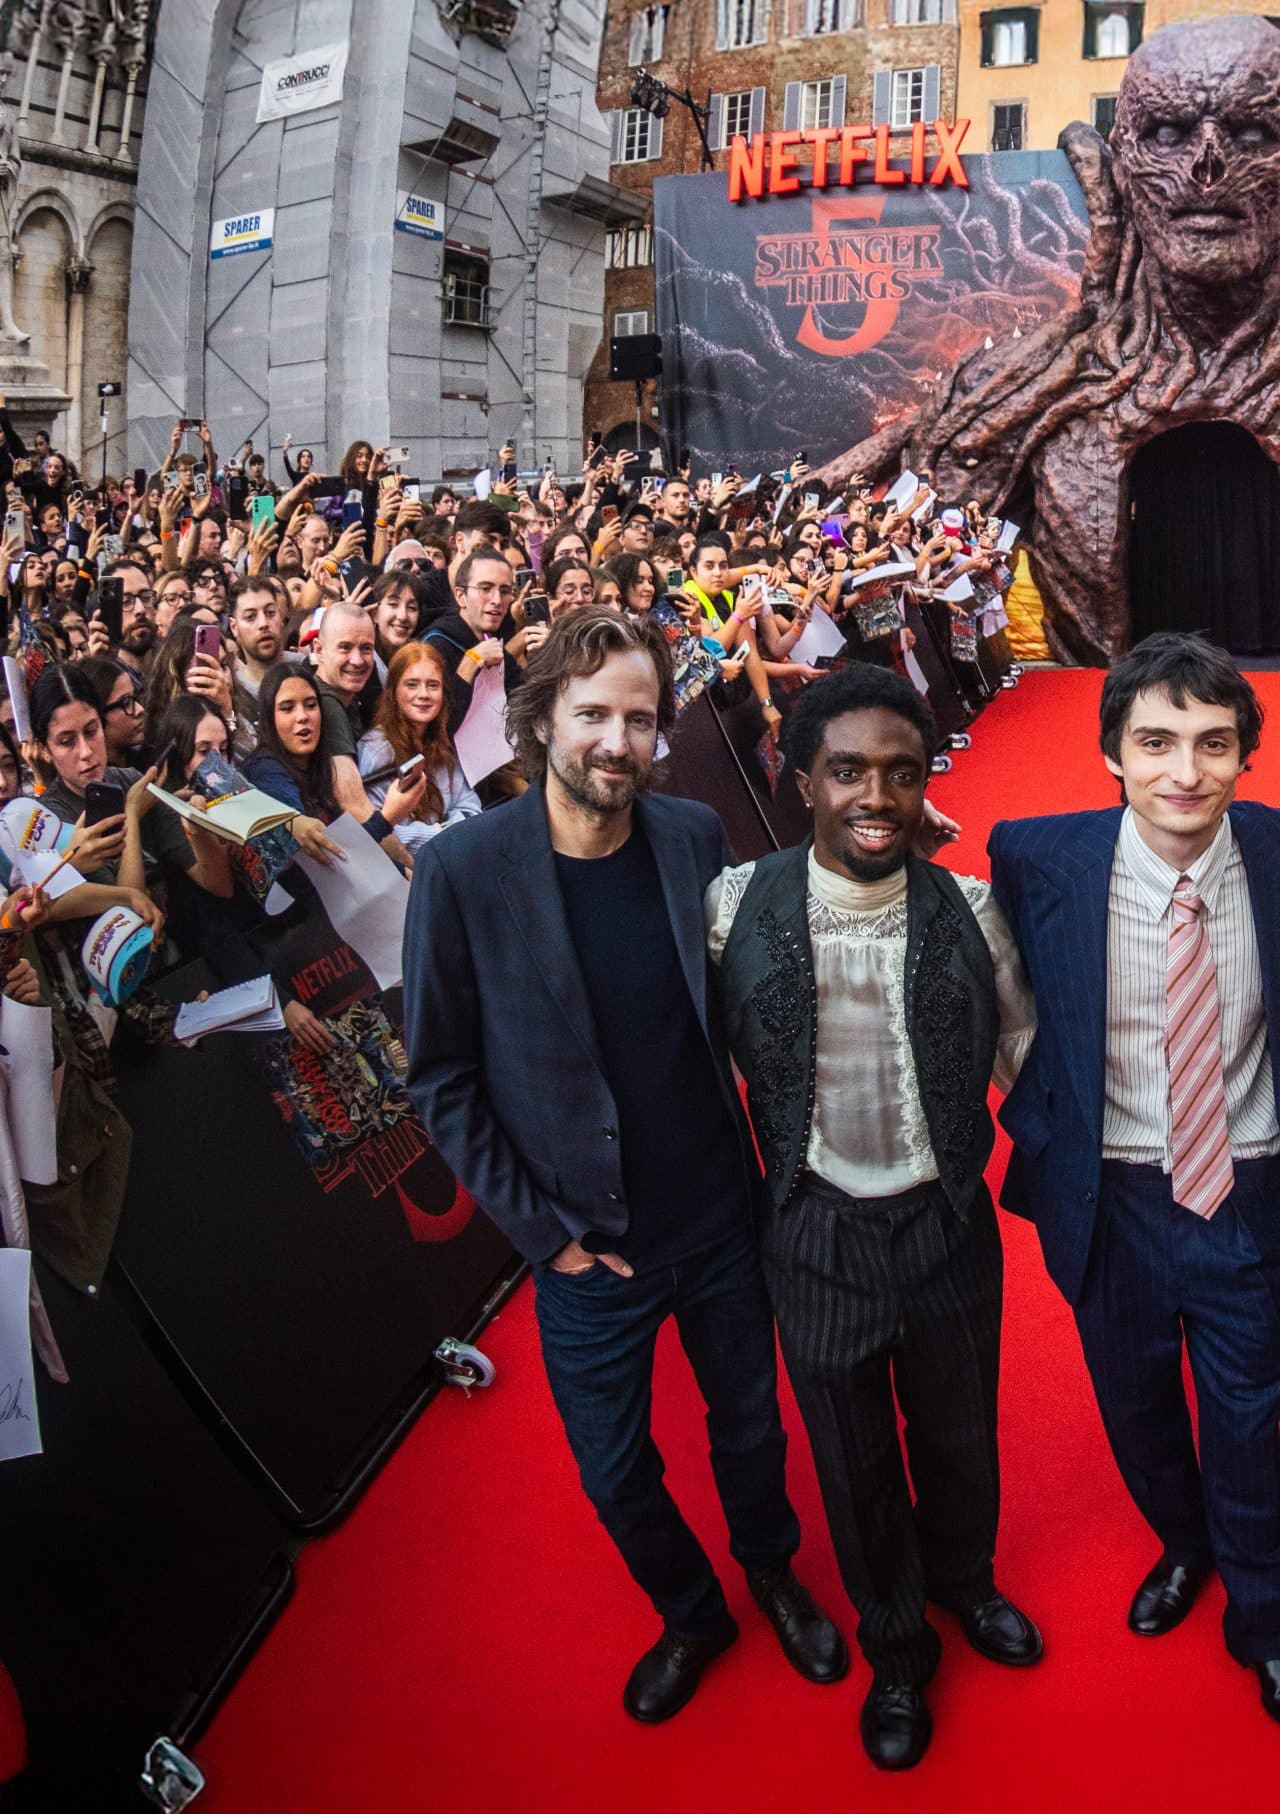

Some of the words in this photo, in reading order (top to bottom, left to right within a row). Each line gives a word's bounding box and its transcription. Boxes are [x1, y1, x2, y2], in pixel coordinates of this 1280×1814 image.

[728, 118, 971, 203] NETFLIX
[224, 215, 261, 238] SPARER
[407, 196, 436, 219] SPARER
[754, 231, 945, 280] STRANGER
[784, 268, 914, 306] THINGS
[290, 944, 360, 1004] NETFLIX
